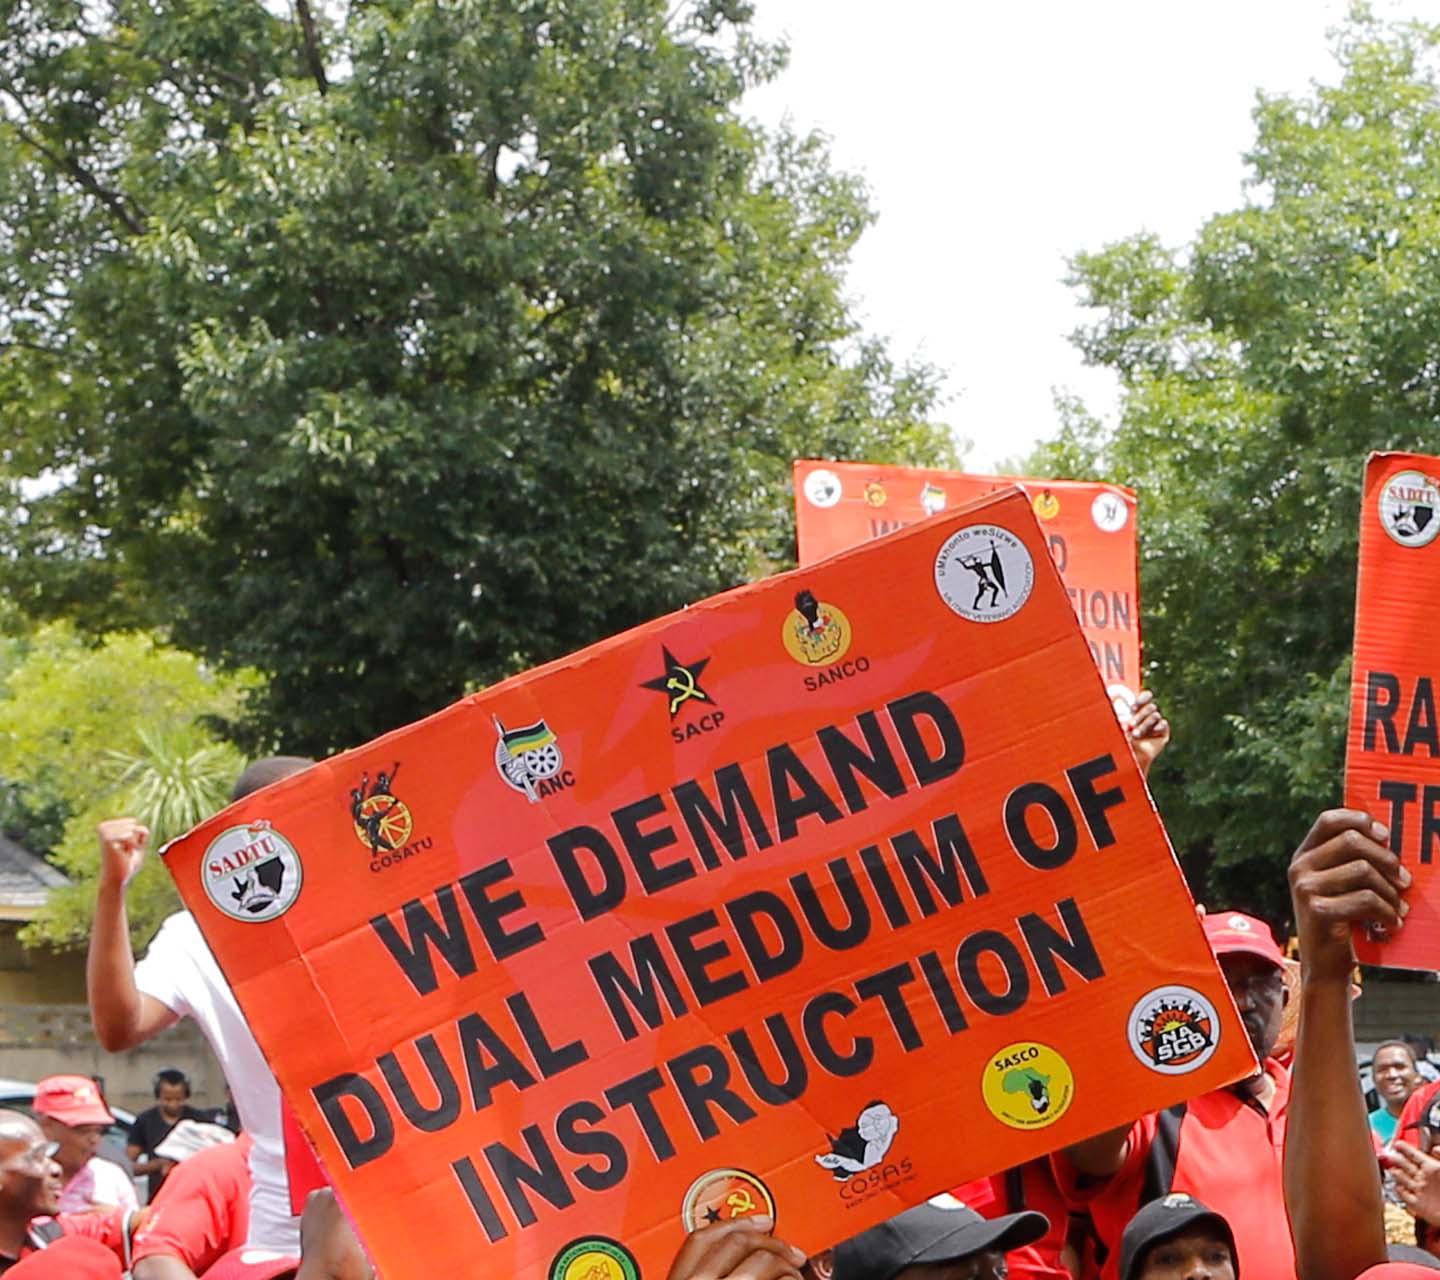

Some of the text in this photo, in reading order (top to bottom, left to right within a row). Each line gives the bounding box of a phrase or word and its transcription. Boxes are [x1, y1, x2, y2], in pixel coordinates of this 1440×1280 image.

[803, 657, 871, 692] SANCO
[670, 711, 727, 744] SACP
[538, 770, 577, 799] ANC
[208, 836, 277, 879] SADTU
[369, 837, 434, 873] COSATU
[370, 692, 966, 995] WE DEMAND
[312, 754, 1126, 1169] DUAL MEDUIM OF
[994, 1047, 1039, 1072] SASCO
[1158, 1032, 1206, 1060] SGB
[452, 898, 1104, 1242] INSTRUCTION
[839, 1158, 913, 1200] COSAS
